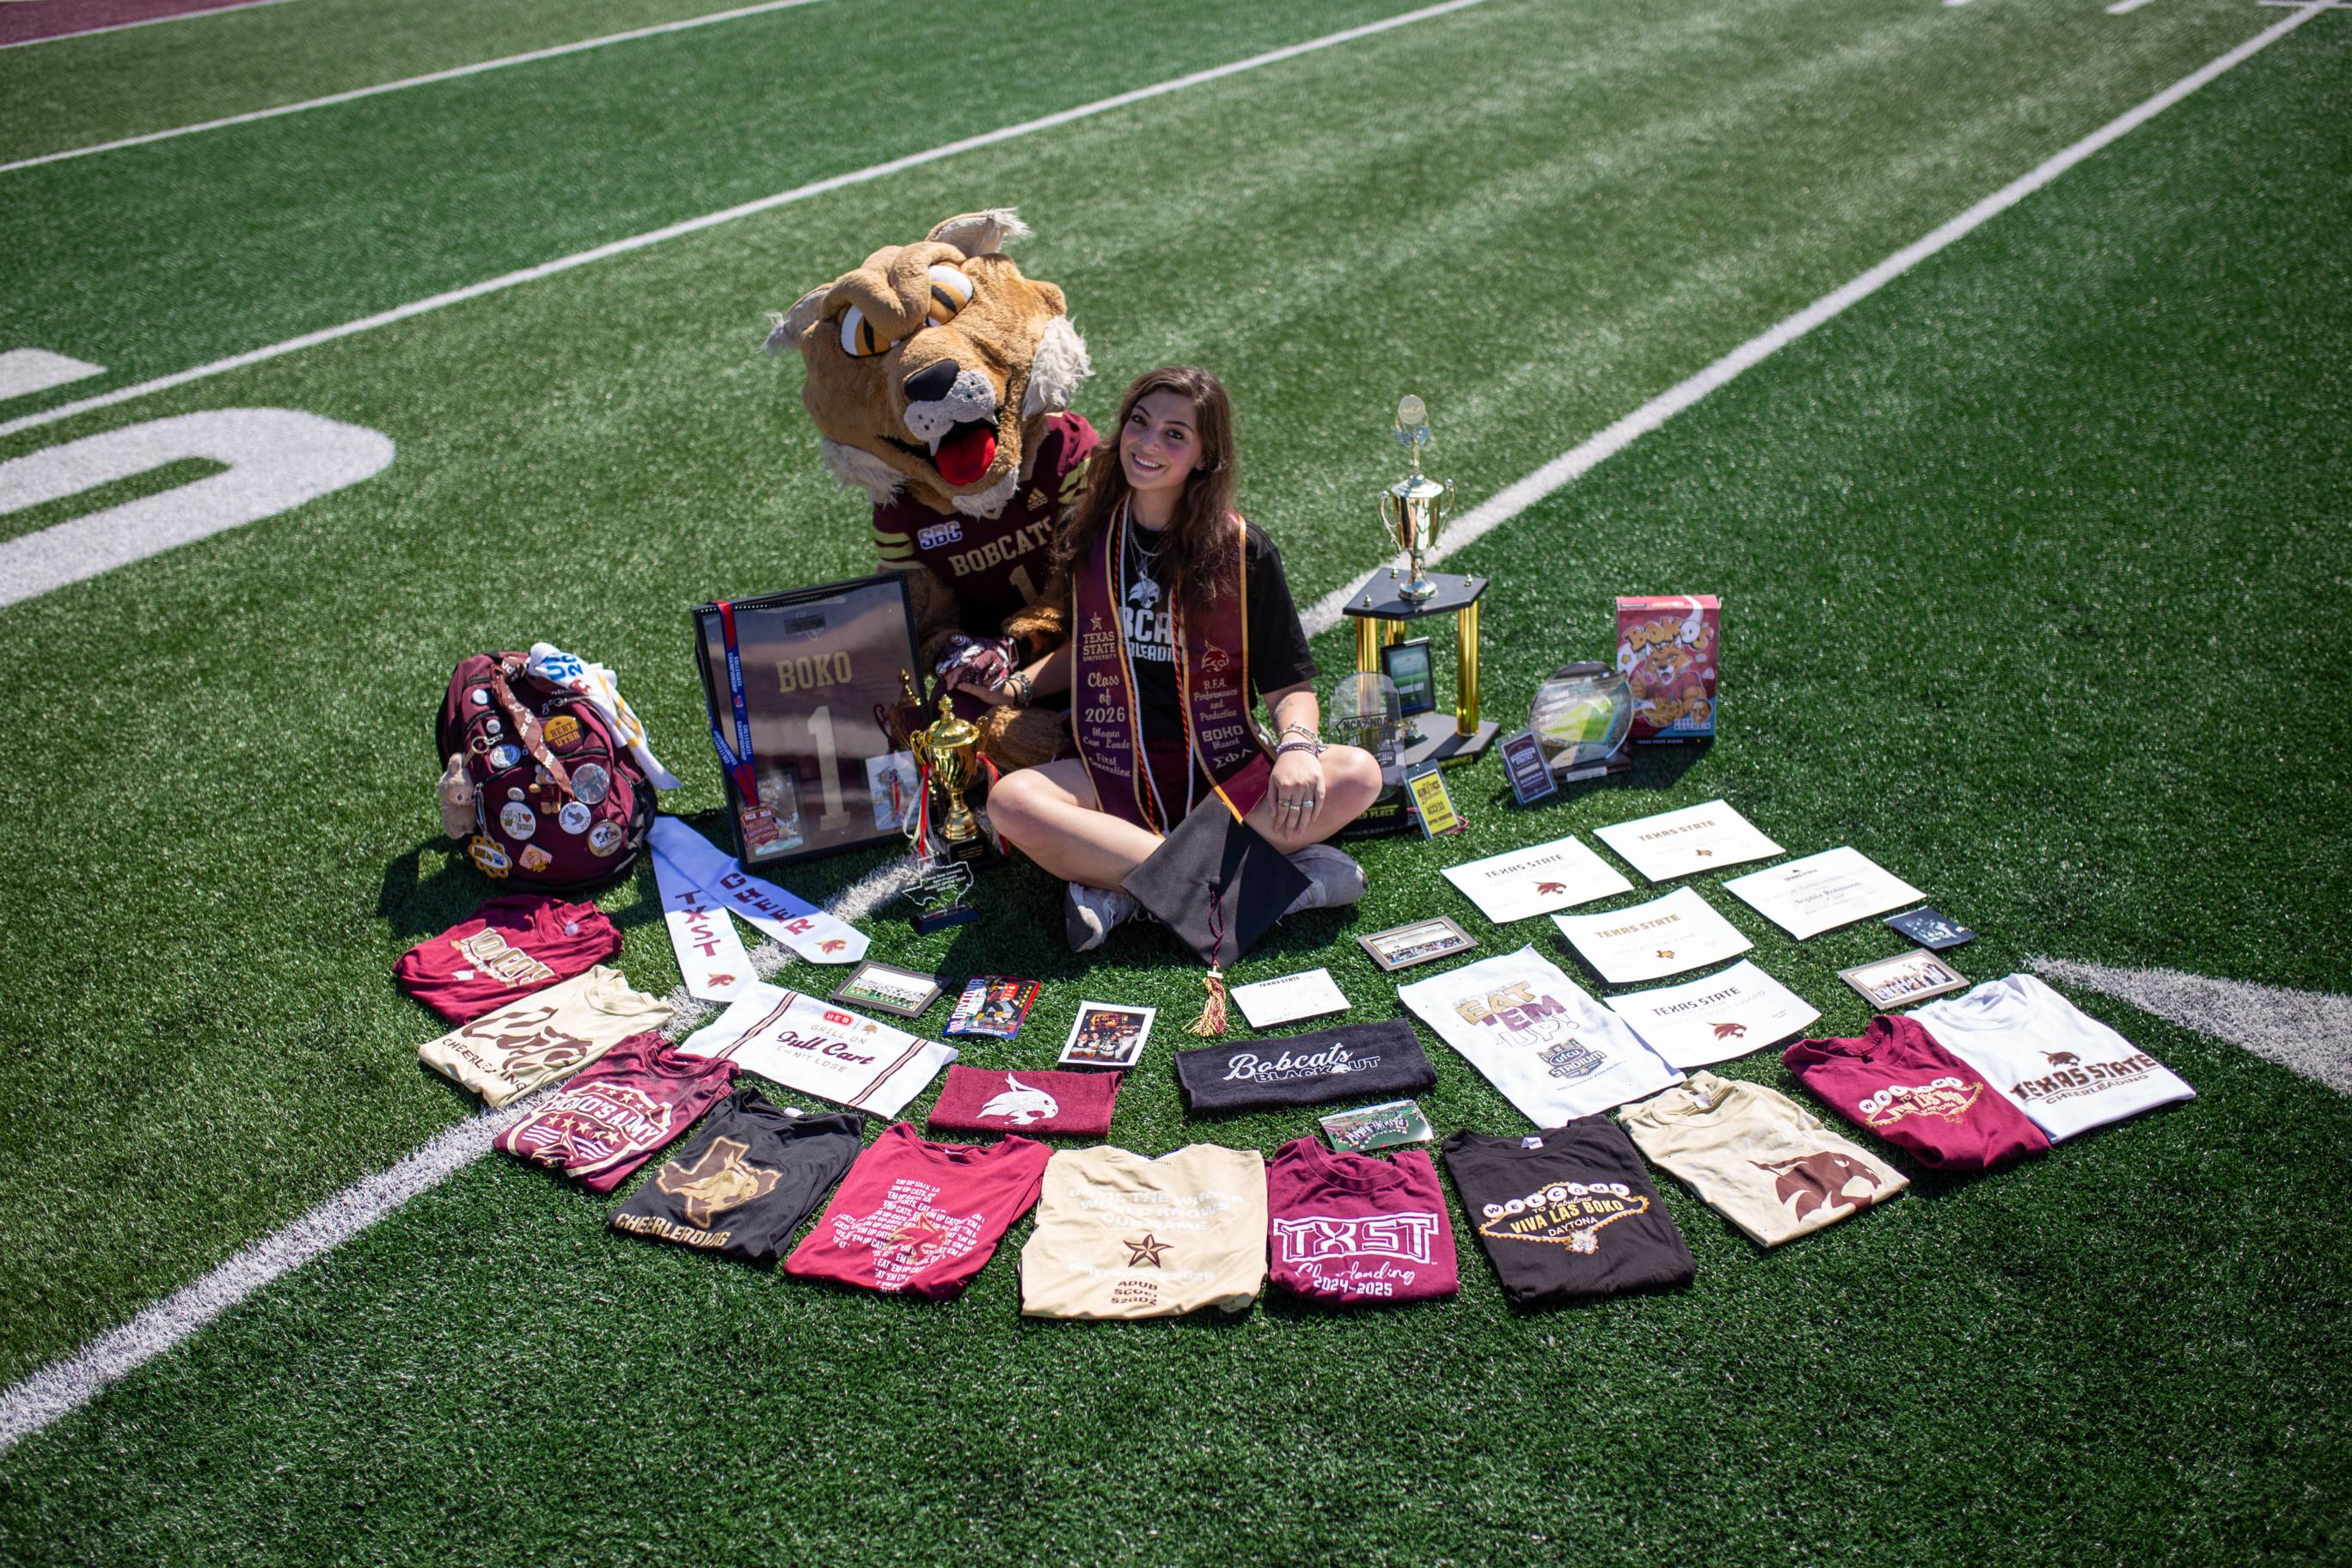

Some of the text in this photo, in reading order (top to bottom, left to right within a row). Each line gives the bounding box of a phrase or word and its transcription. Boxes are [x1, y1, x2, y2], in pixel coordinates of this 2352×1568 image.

[917, 520, 963, 550] SBC
[1118, 606, 1182, 646] BCA
[1082, 632, 1116, 645] TEXAS
[1082, 643, 1116, 656] STATE
[775, 651, 853, 693] BOKO
[1087, 673, 1119, 688] Class
[1204, 679, 1228, 690] B.F.A.
[1099, 689, 1112, 704] of
[1193, 689, 1238, 701] Performance
[1210, 700, 1224, 709] and
[1085, 707, 1125, 723] 2026
[1199, 709, 1237, 722] Production
[1344, 720, 1362, 730] NCA
[554, 732, 581, 747] UTSA
[1092, 727, 1120, 738] Magna
[1203, 725, 1244, 743] BOKO
[1083, 737, 1130, 750] Cum Laude
[1212, 738, 1240, 750] Mascot
[806, 705, 851, 831] 1
[1095, 753, 1118, 766] First
[1638, 819, 1716, 842] TEXAS STATE
[1485, 863, 1526, 878] TEXAS
[1527, 854, 1565, 867] STATE
[719, 873, 816, 935] CHEER
[675, 890, 721, 957] TXST
[1595, 914, 1681, 940] TEXAS STATE
[1281, 976, 1301, 985] STATE
[1455, 980, 1535, 1026] EAT
[1651, 1001, 1698, 1016] TEXAS
[1698, 987, 1741, 1005] STATE
[811, 1024, 867, 1045] GRILL ON
[1498, 1014, 1580, 1047] UP!
[822, 1043, 876, 1064] Cart
[1222, 1042, 1353, 1081] Bobcats
[1555, 1049, 1580, 1063] ufcu
[814, 1057, 847, 1073] LOSE
[1253, 1056, 1381, 1083] BLACKUT
[1549, 1050, 1608, 1078] STADIUM
[2009, 1053, 2158, 1101] TEXAS STATE
[1899, 1093, 1912, 1104] TO
[2044, 1073, 2150, 1106] CHEERLEADING
[1132, 1191, 1170, 1204] THE
[1485, 1184, 1628, 1216] WELCOME
[1550, 1196, 1593, 1209] Fabulous
[1510, 1199, 1625, 1234] VIVA LAS BOKO
[1548, 1216, 1599, 1238] DAYTONA
[1273, 1212, 1438, 1264] TXST
[1313, 1277, 1393, 1296] 2024-2025
